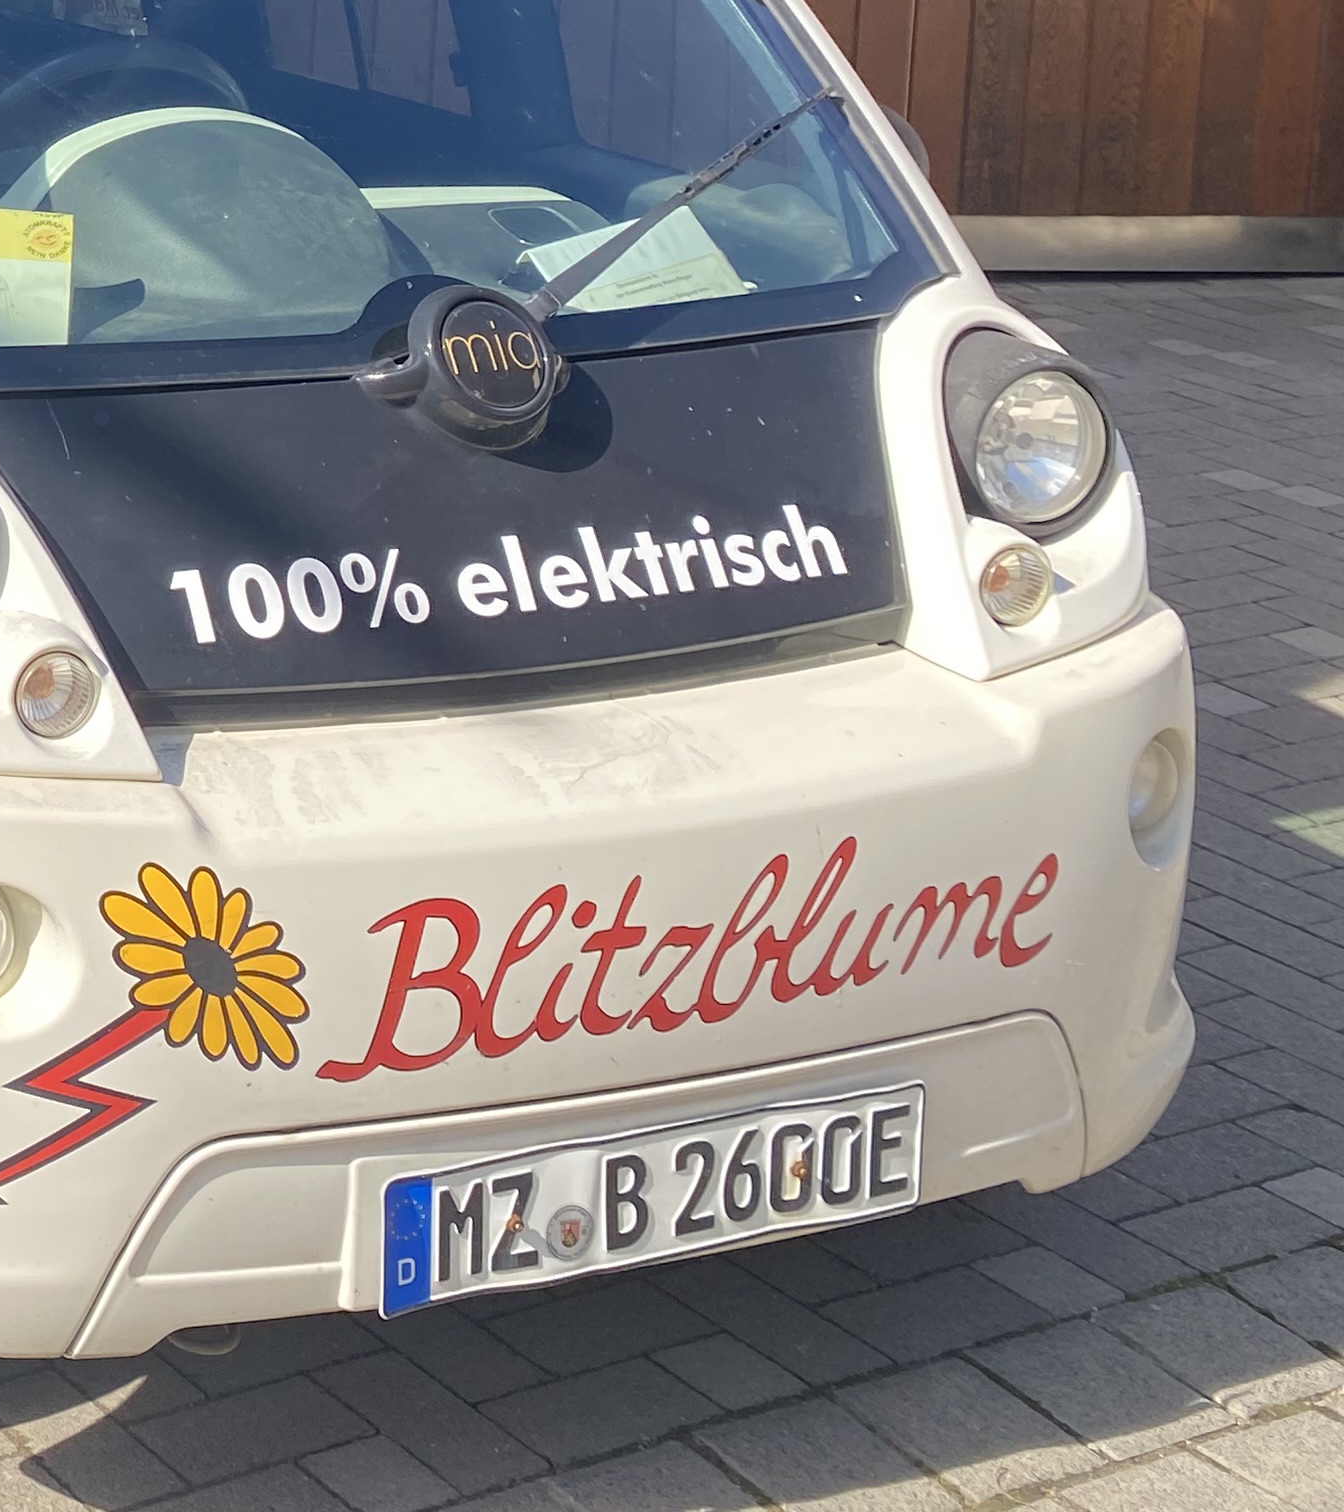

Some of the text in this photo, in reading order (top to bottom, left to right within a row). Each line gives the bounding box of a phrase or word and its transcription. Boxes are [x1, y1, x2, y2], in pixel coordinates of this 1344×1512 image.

[23, 219, 71, 238] ATOMKRAFT?
[26, 240, 72, 259] NEIN DANKE
[169, 503, 849, 645] 100% elektrisch
[314, 835, 1059, 1083] Blitzblume
[397, 1257, 417, 1287] D
[438, 1172, 540, 1283] MZ
[605, 1154, 650, 1253] B
